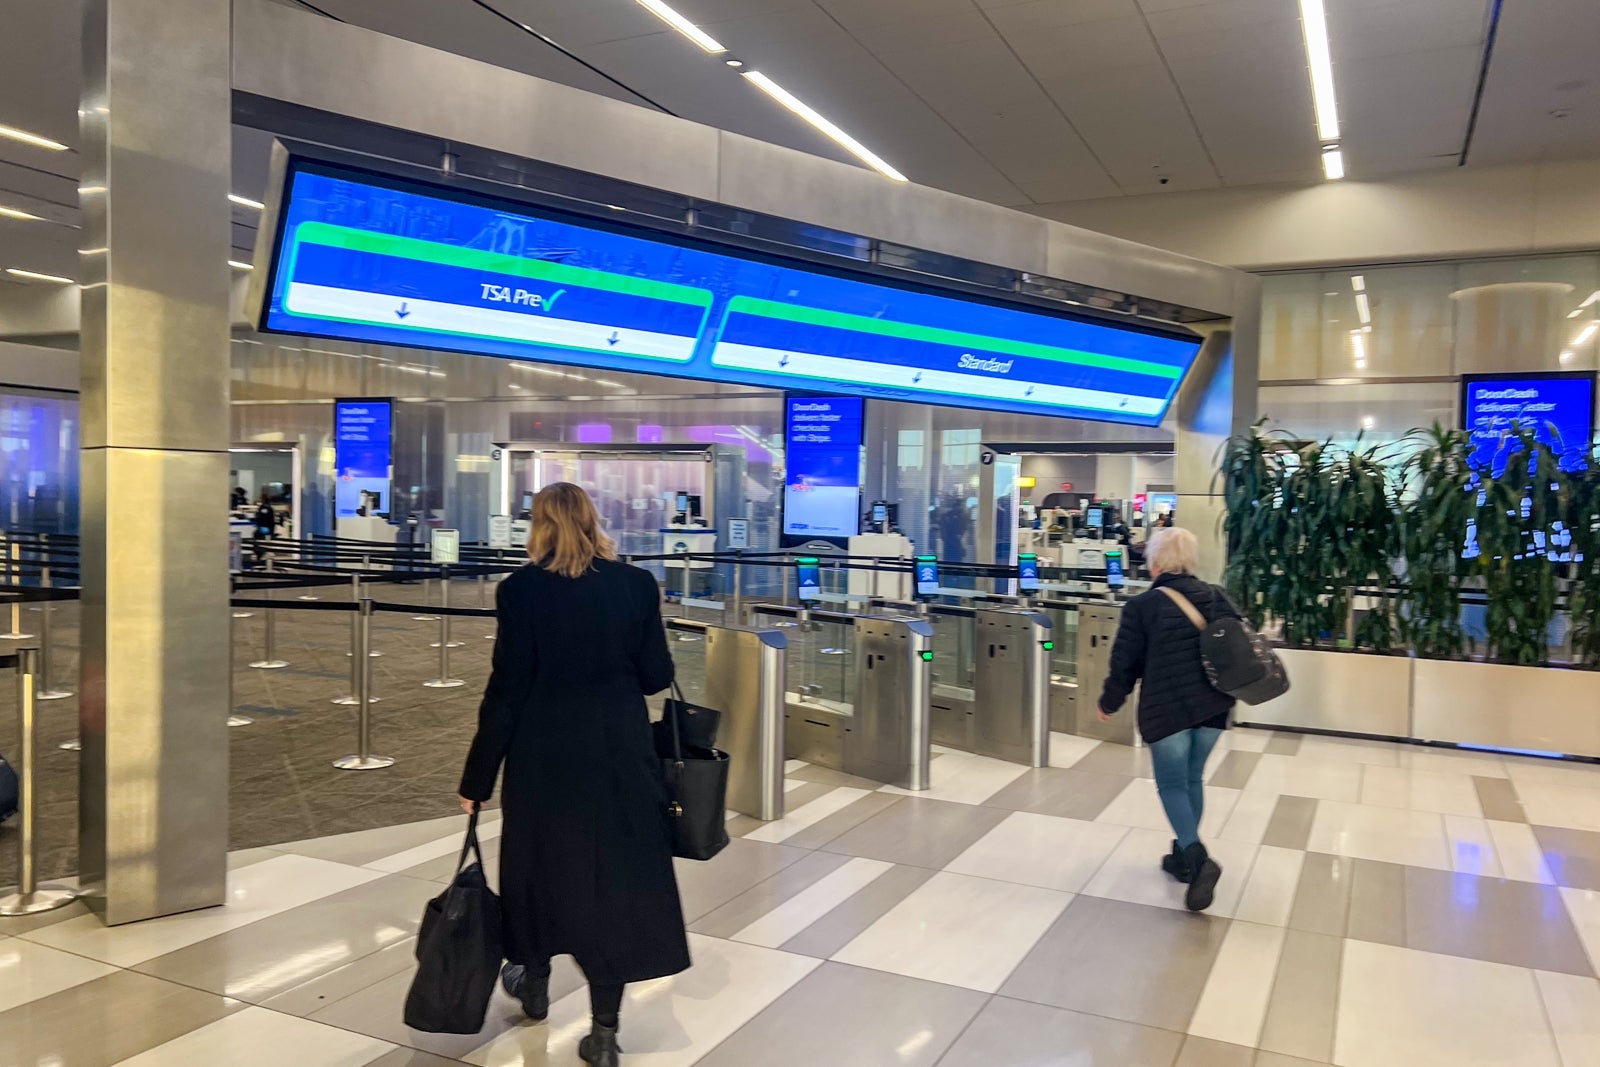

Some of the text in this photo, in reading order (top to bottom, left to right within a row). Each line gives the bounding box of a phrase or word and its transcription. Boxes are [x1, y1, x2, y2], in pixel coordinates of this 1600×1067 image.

[480, 283, 511, 303] TSA
[957, 353, 1014, 374] Standard
[1475, 388, 1539, 399] DoorDash
[983, 454, 991, 463] 7
